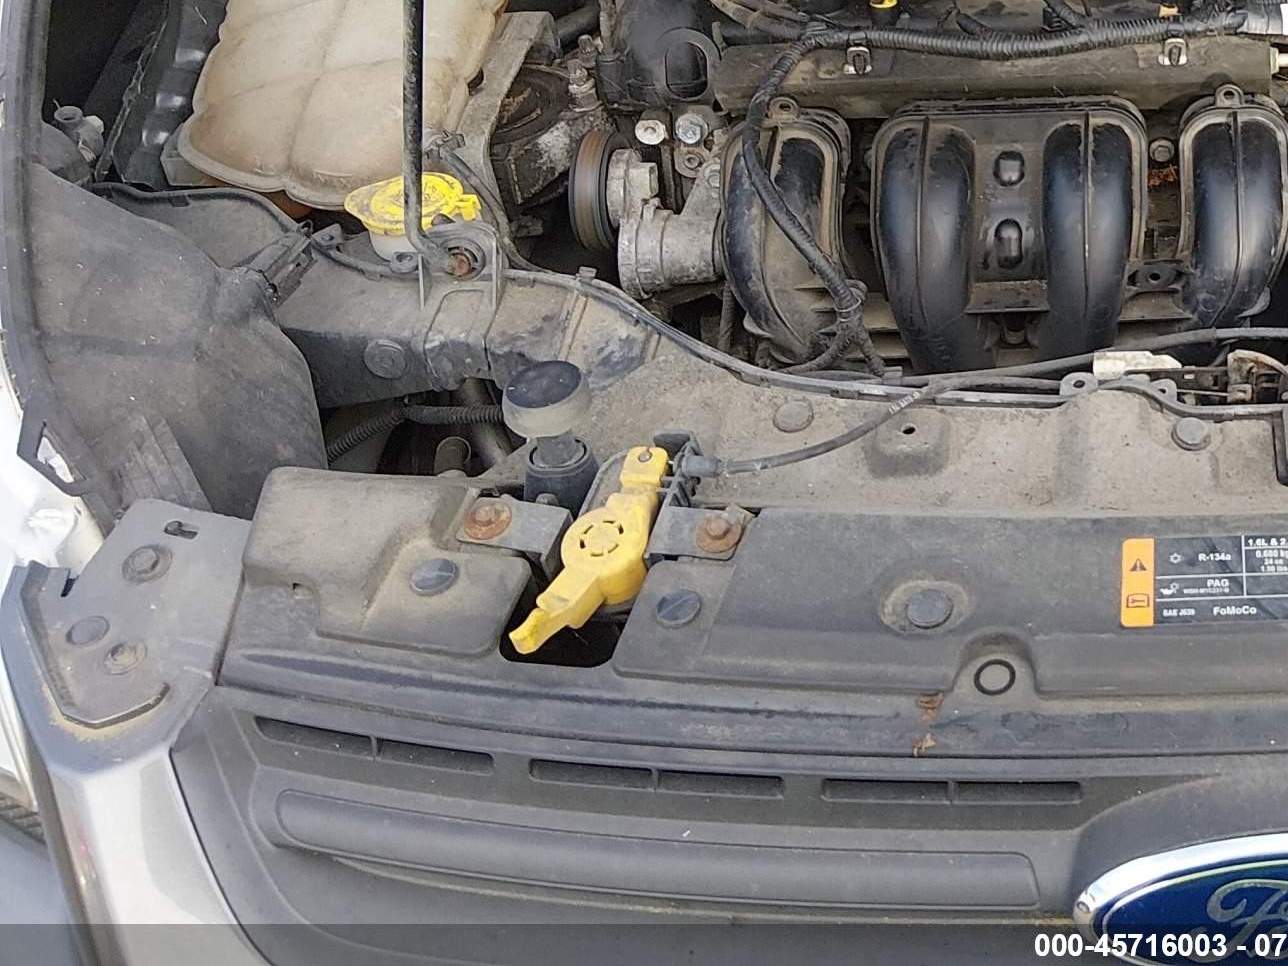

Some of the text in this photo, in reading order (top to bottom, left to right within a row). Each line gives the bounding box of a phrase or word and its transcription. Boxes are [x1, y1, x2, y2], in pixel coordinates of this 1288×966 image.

[1248, 538, 1268, 547] 1.6L
[1270, 538, 1278, 546] &
[1198, 553, 1232, 562] R-134a
[1207, 579, 1229, 587] PAG
[1213, 605, 1257, 616] FoMoCo
